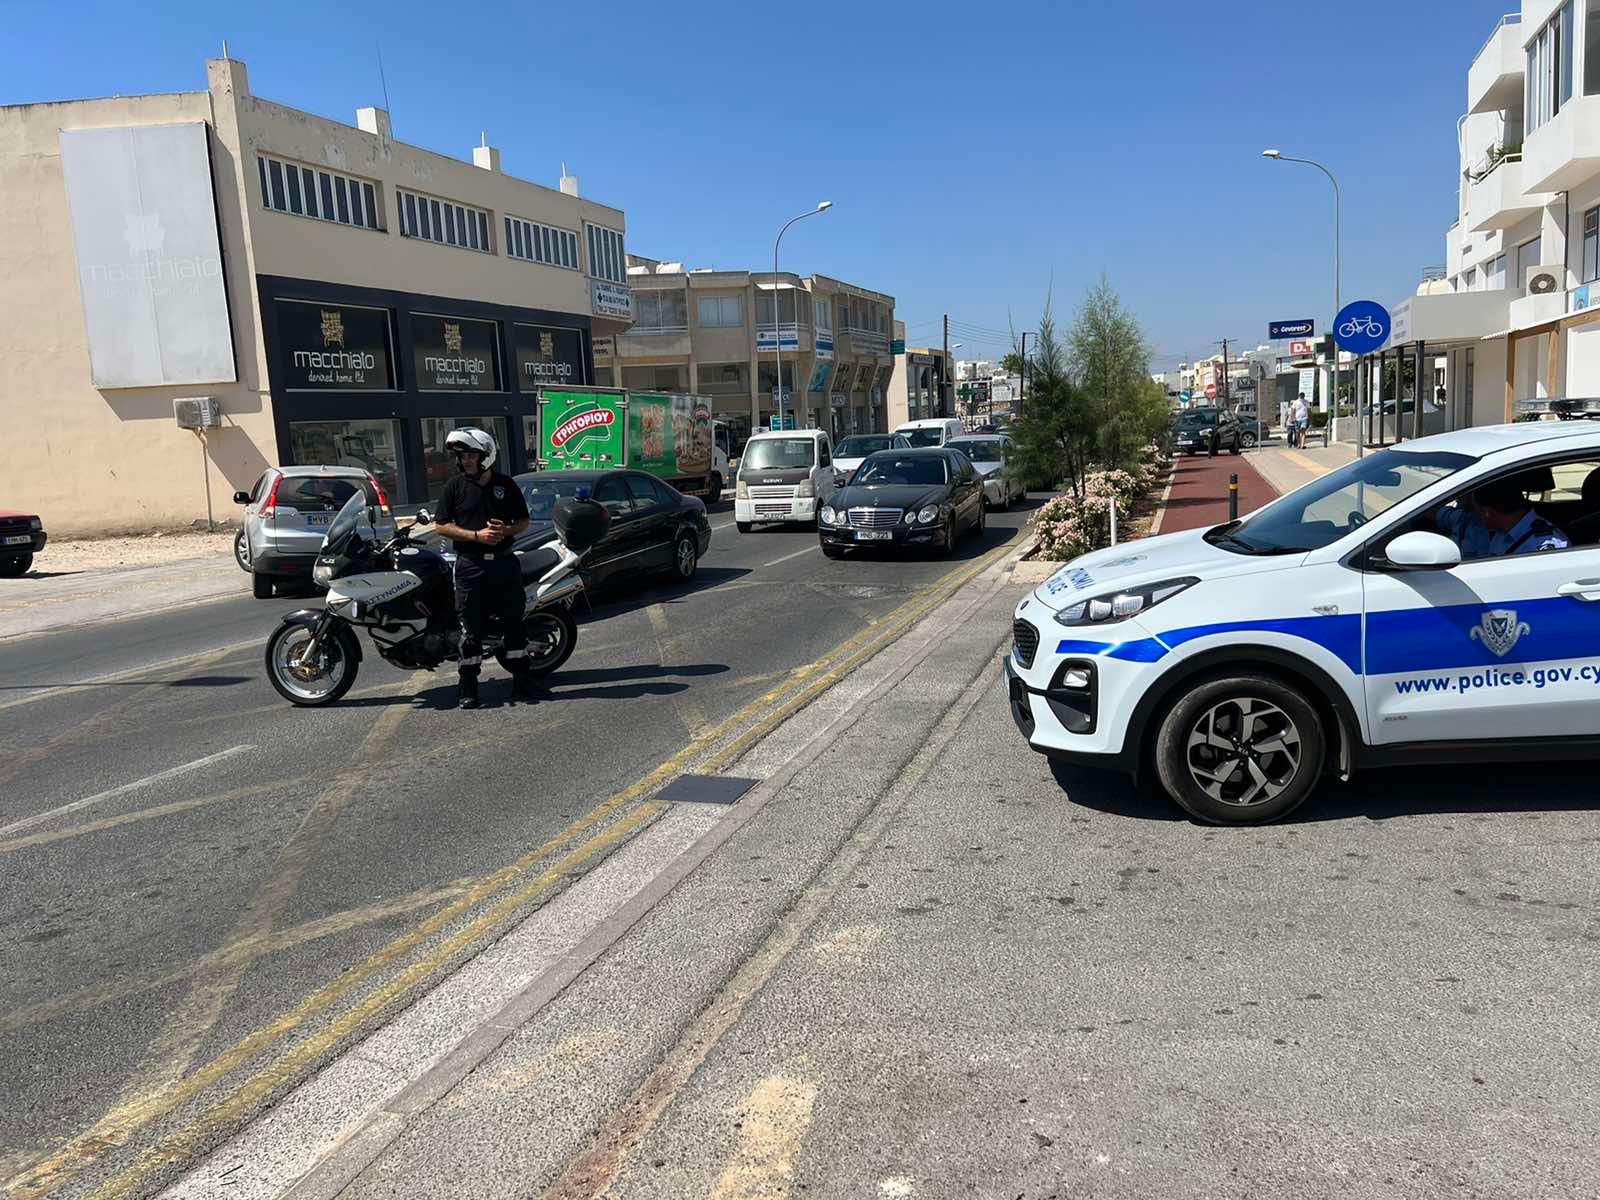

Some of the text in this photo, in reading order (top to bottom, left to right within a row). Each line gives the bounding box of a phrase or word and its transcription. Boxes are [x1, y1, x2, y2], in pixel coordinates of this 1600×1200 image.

[1280, 325, 1306, 333] Gevorest
[293, 350, 375, 369] macchiato
[424, 356, 486, 374] macchiato
[524, 361, 572, 376] macchiato
[556, 411, 609, 443] ΓΡΗΓΟΡΙΟΥ
[1395, 665, 1600, 694] www.police.gov.cy
